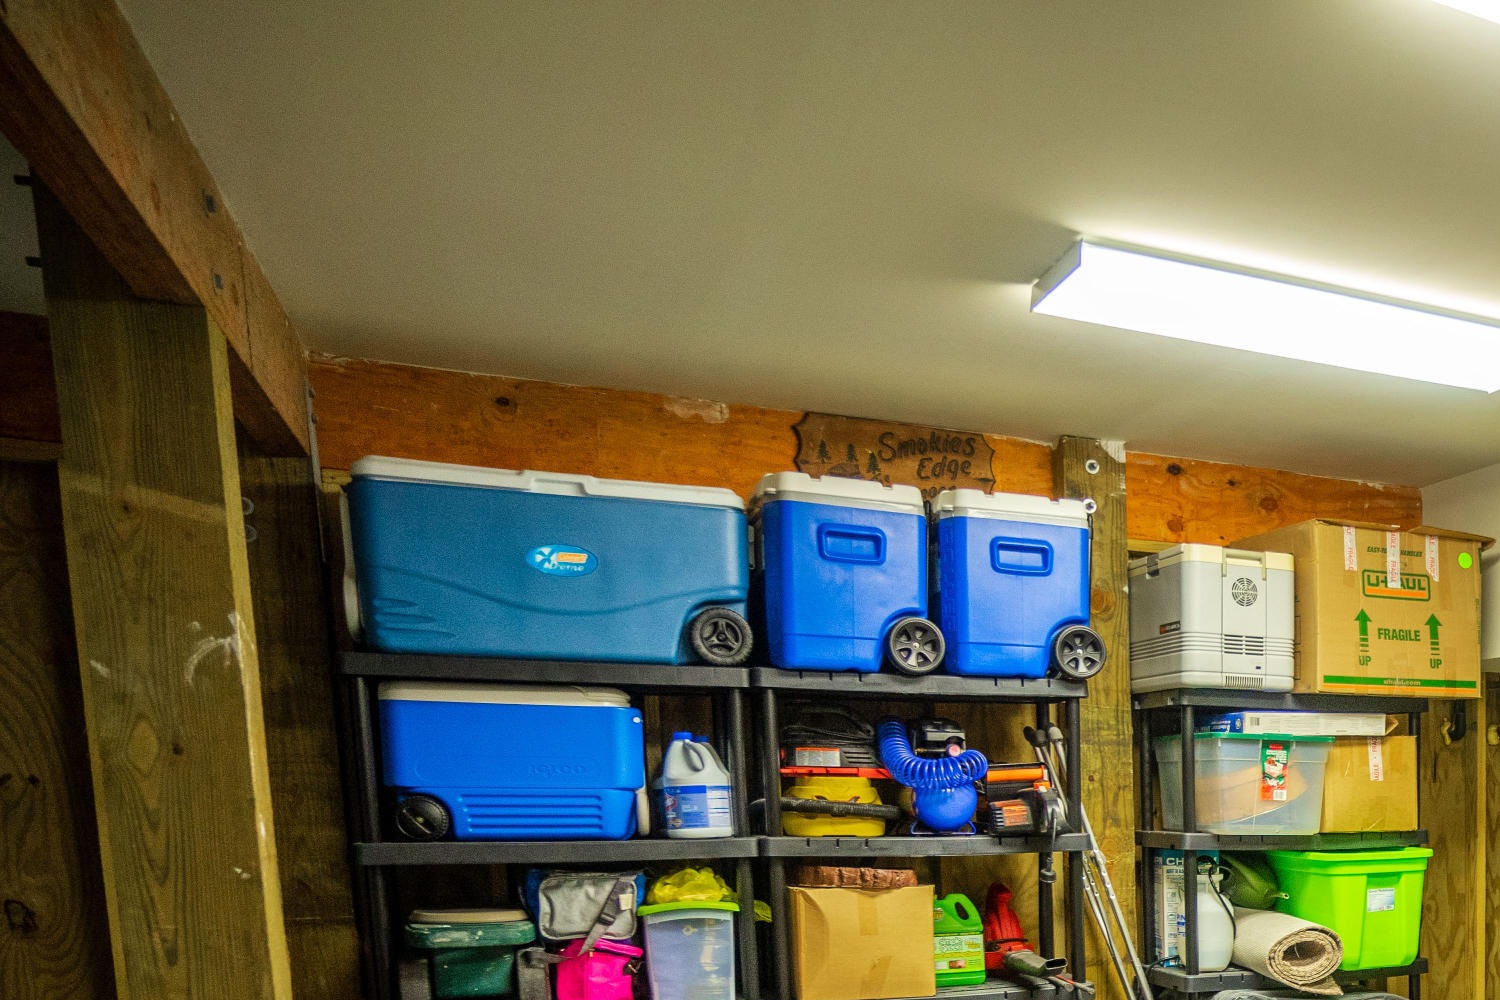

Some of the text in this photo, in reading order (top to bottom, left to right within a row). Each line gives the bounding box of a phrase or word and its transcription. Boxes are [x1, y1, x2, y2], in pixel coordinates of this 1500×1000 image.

[877, 431, 977, 463] Smokies
[917, 456, 973, 481] Edge
[1367, 574, 1426, 591] U-AUL
[1377, 627, 1421, 642] FRAGILE
[1359, 655, 1371, 666] UP
[1430, 658, 1442, 669] UP
